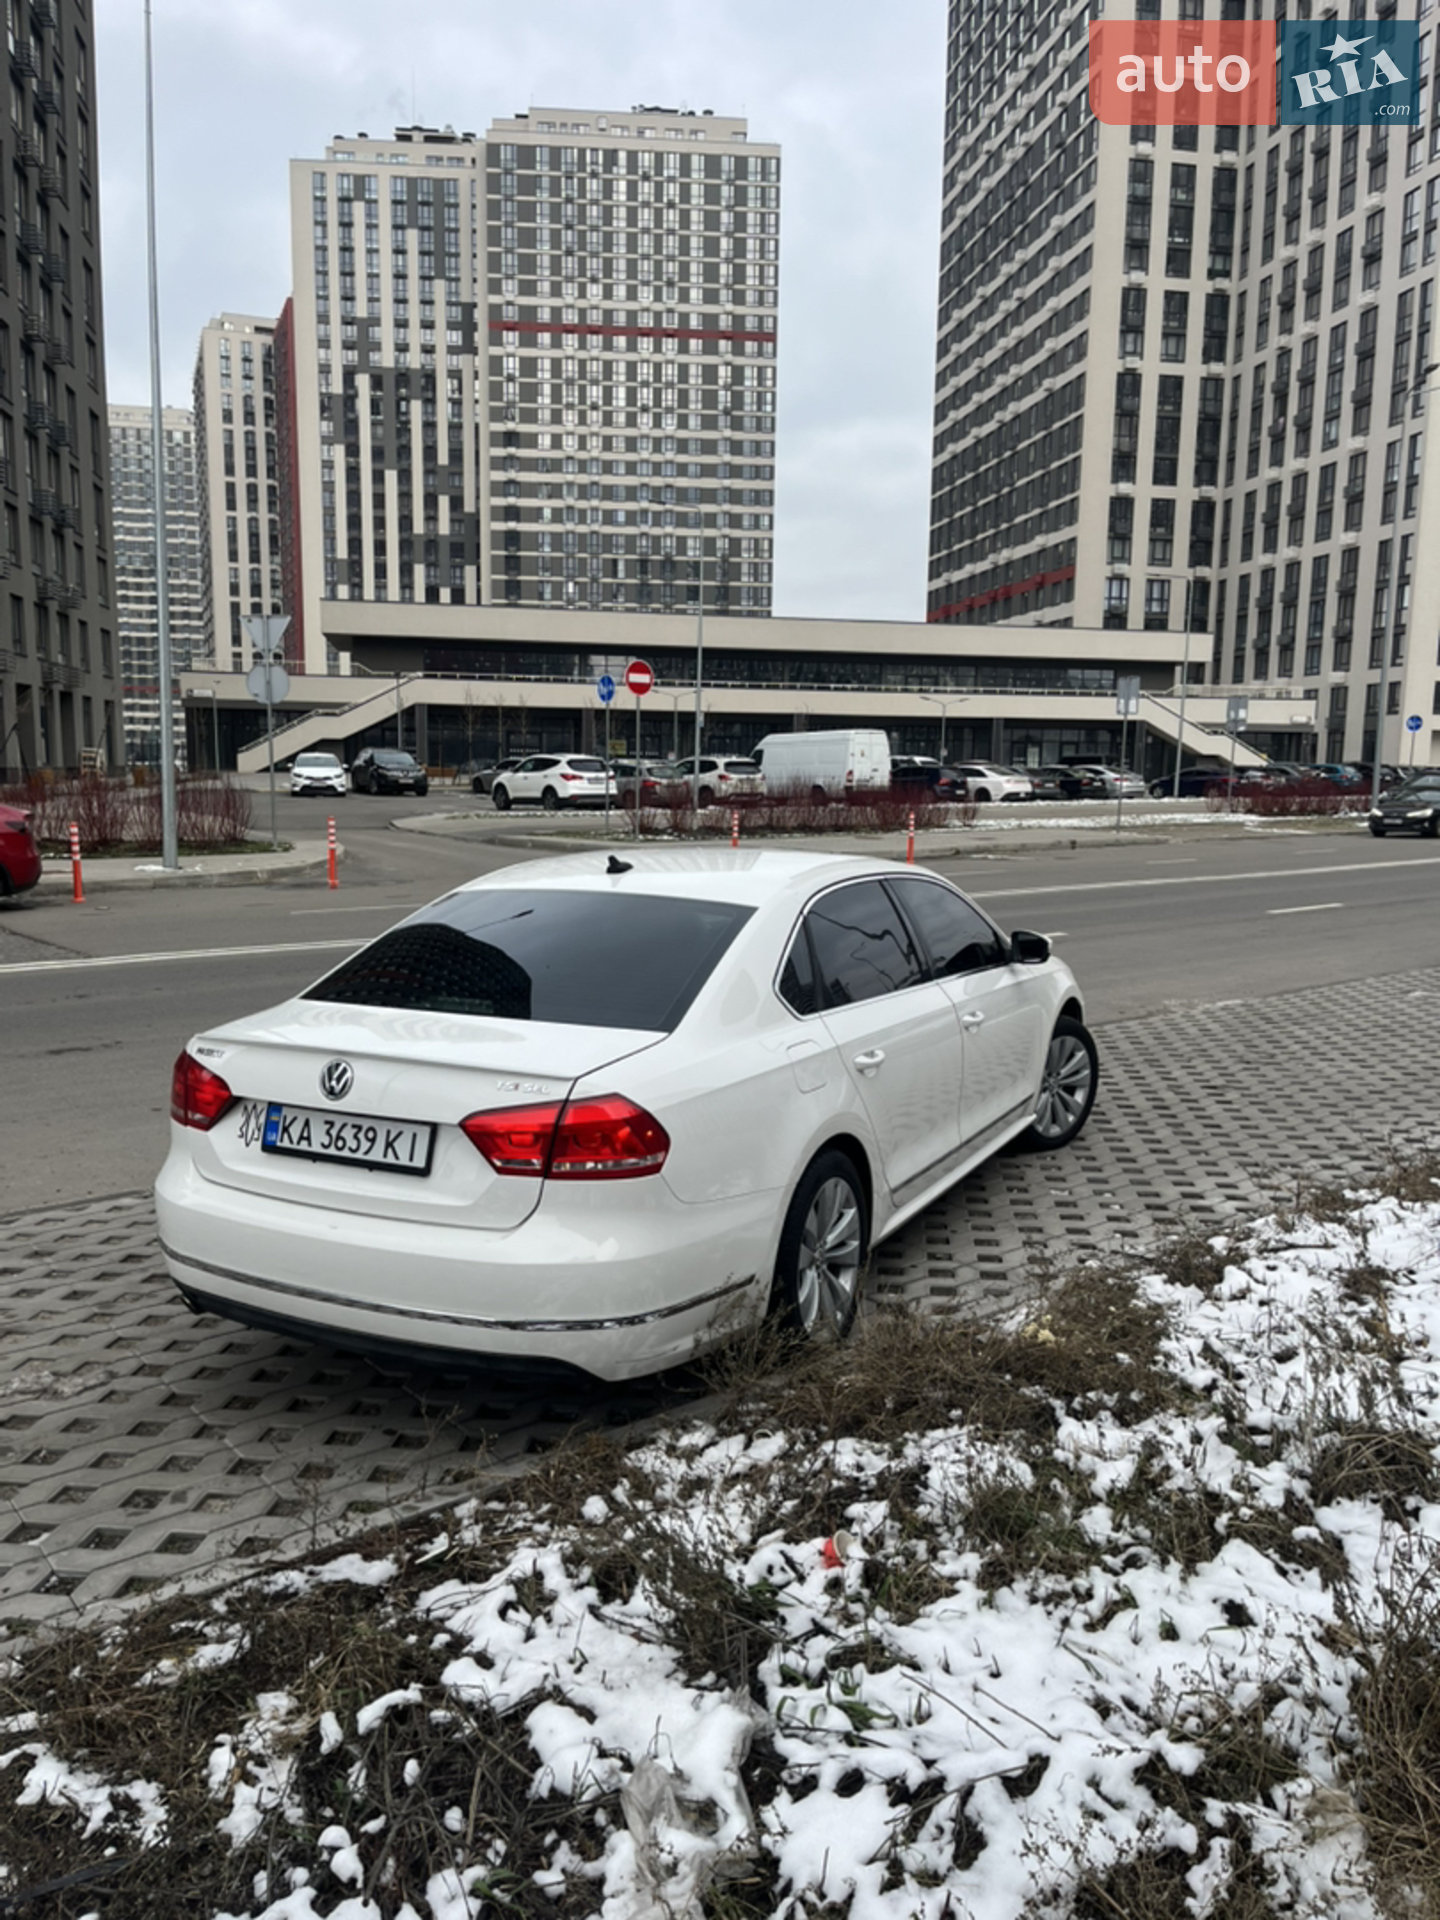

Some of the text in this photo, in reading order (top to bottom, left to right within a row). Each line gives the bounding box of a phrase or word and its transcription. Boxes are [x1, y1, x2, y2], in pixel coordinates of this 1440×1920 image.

[279, 1114, 418, 1163] KA 3639 KI
